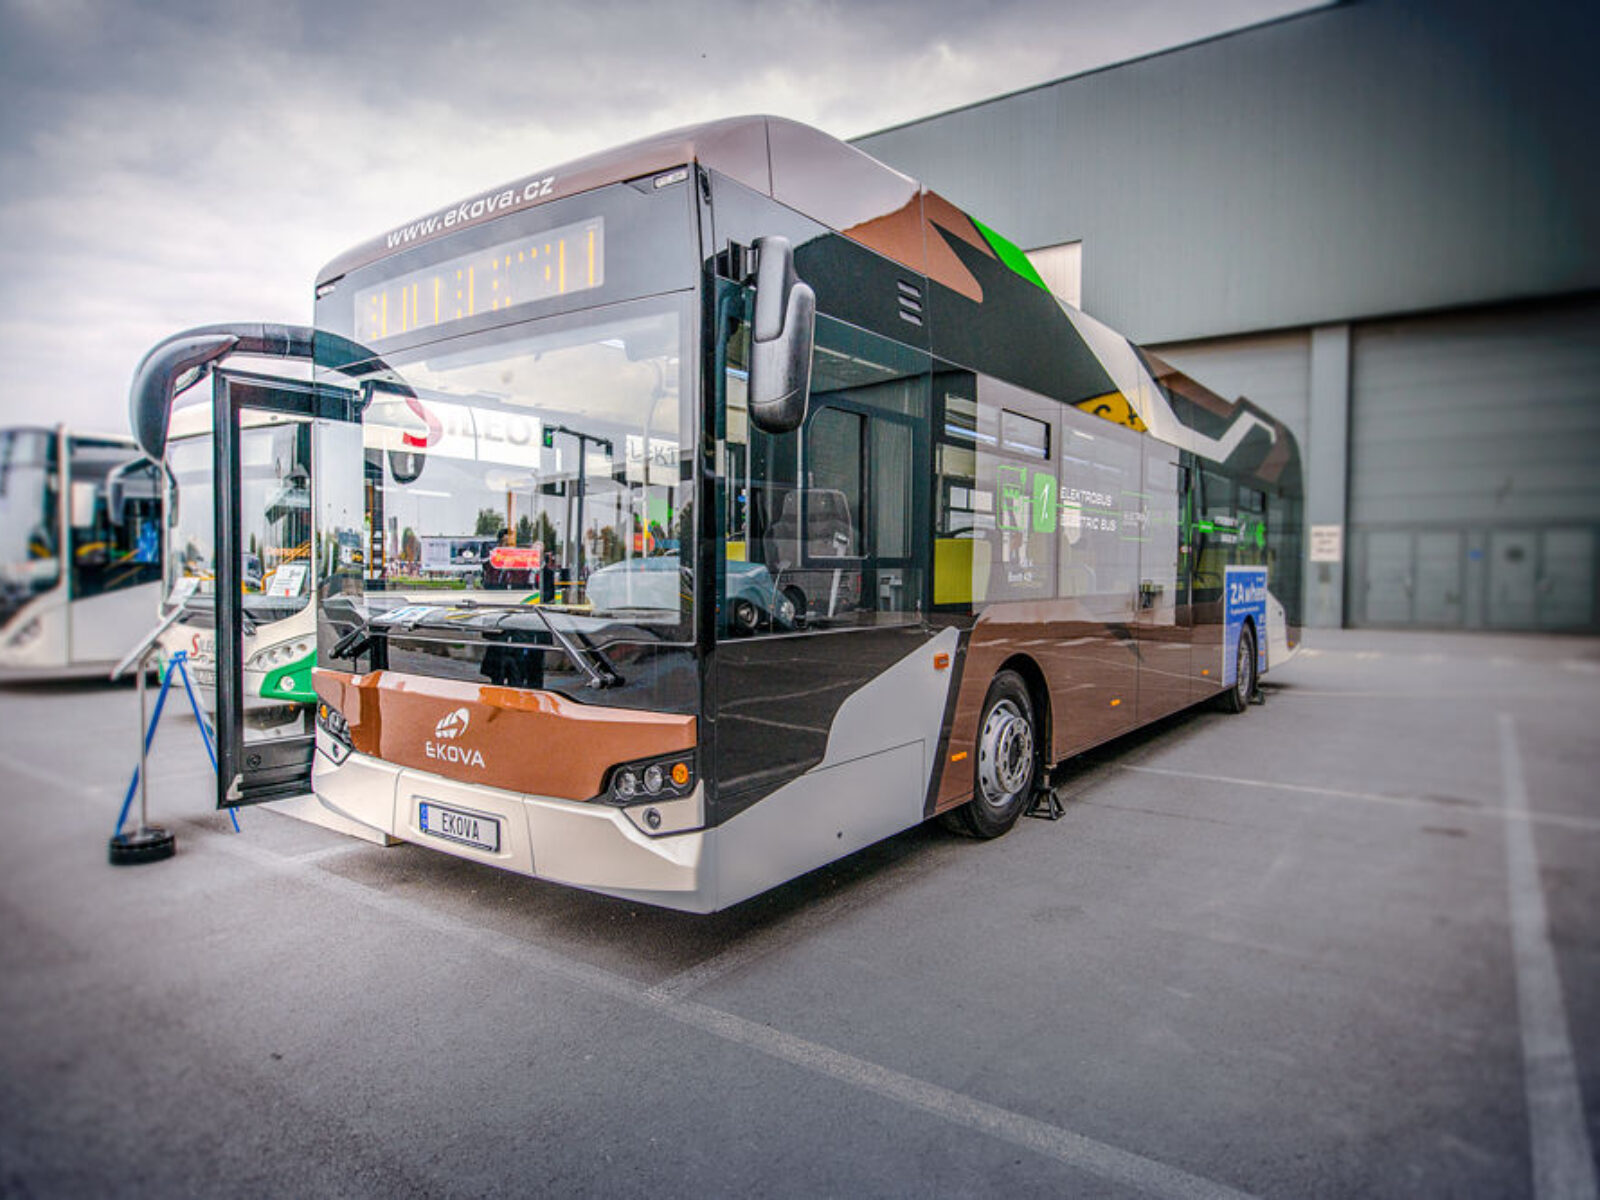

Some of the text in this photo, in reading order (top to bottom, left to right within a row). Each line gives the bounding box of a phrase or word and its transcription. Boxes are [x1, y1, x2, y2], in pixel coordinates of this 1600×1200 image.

[387, 176, 555, 249] www.ekova.cz
[1060, 486, 1112, 507] ELEKTROBUS
[1060, 513, 1099, 530] ETRIC
[1100, 518, 1117, 532] BUS
[425, 740, 486, 769] EKOVA
[442, 812, 480, 841] EKOVA
